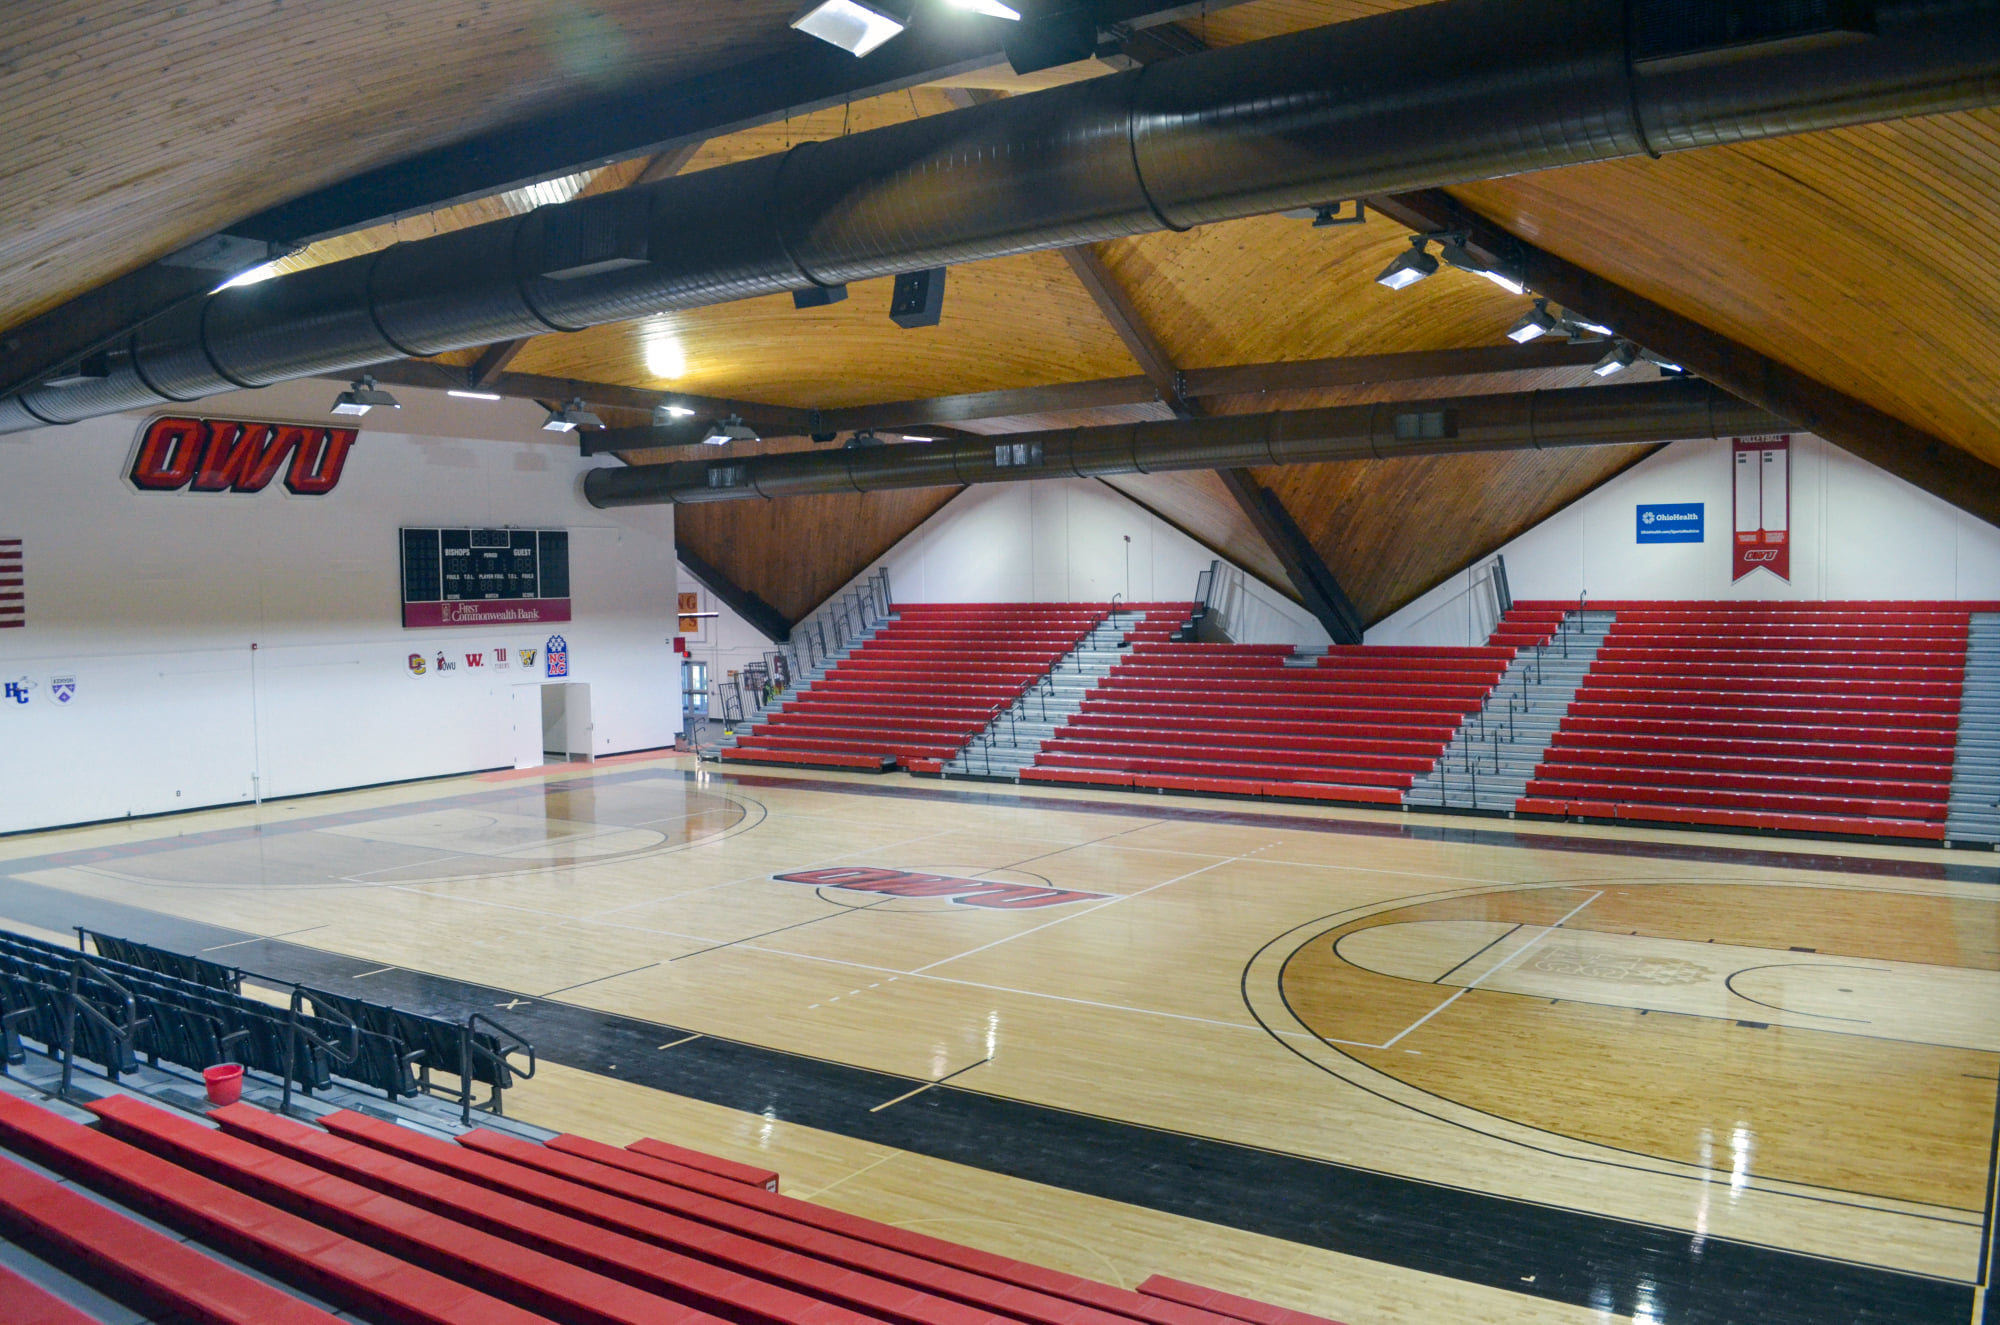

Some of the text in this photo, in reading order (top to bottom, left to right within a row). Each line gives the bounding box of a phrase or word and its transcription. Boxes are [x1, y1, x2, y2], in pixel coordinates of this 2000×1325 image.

[129, 416, 359, 495] OWU
[1656, 512, 1698, 521] OhioHealth
[445, 548, 470, 556] BISHOPS
[513, 548, 531, 556] GUEST
[1744, 550, 1778, 561] OWU
[458, 603, 479, 613] FIRST
[451, 608, 540, 622] Commonwealth Bank
[548, 653, 565, 663] NC
[549, 664, 566, 674] AC
[771, 866, 1118, 909] OWU
